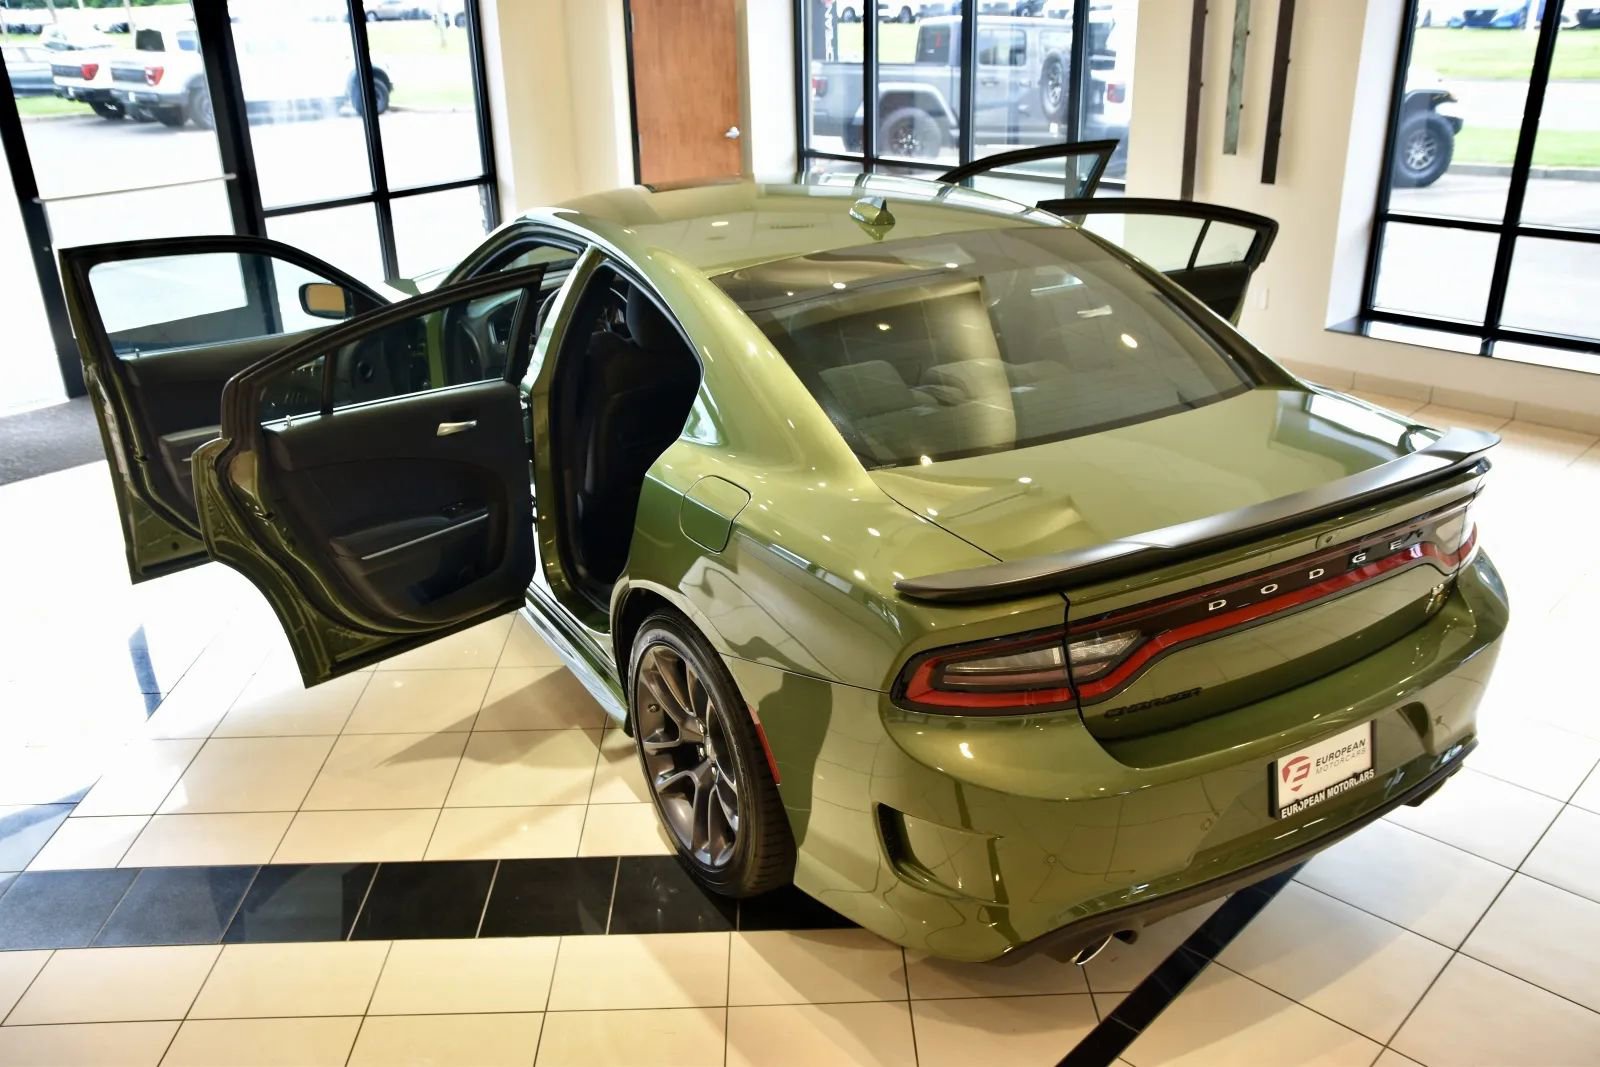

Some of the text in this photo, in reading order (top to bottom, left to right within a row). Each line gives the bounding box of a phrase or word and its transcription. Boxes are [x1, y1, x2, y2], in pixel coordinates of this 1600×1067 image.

[1208, 538, 1402, 611] DODGE
[1315, 738, 1366, 767] EUROPEAN
[1316, 747, 1366, 774] MOTORCARS
[1281, 790, 1326, 819] EUROPEAN
